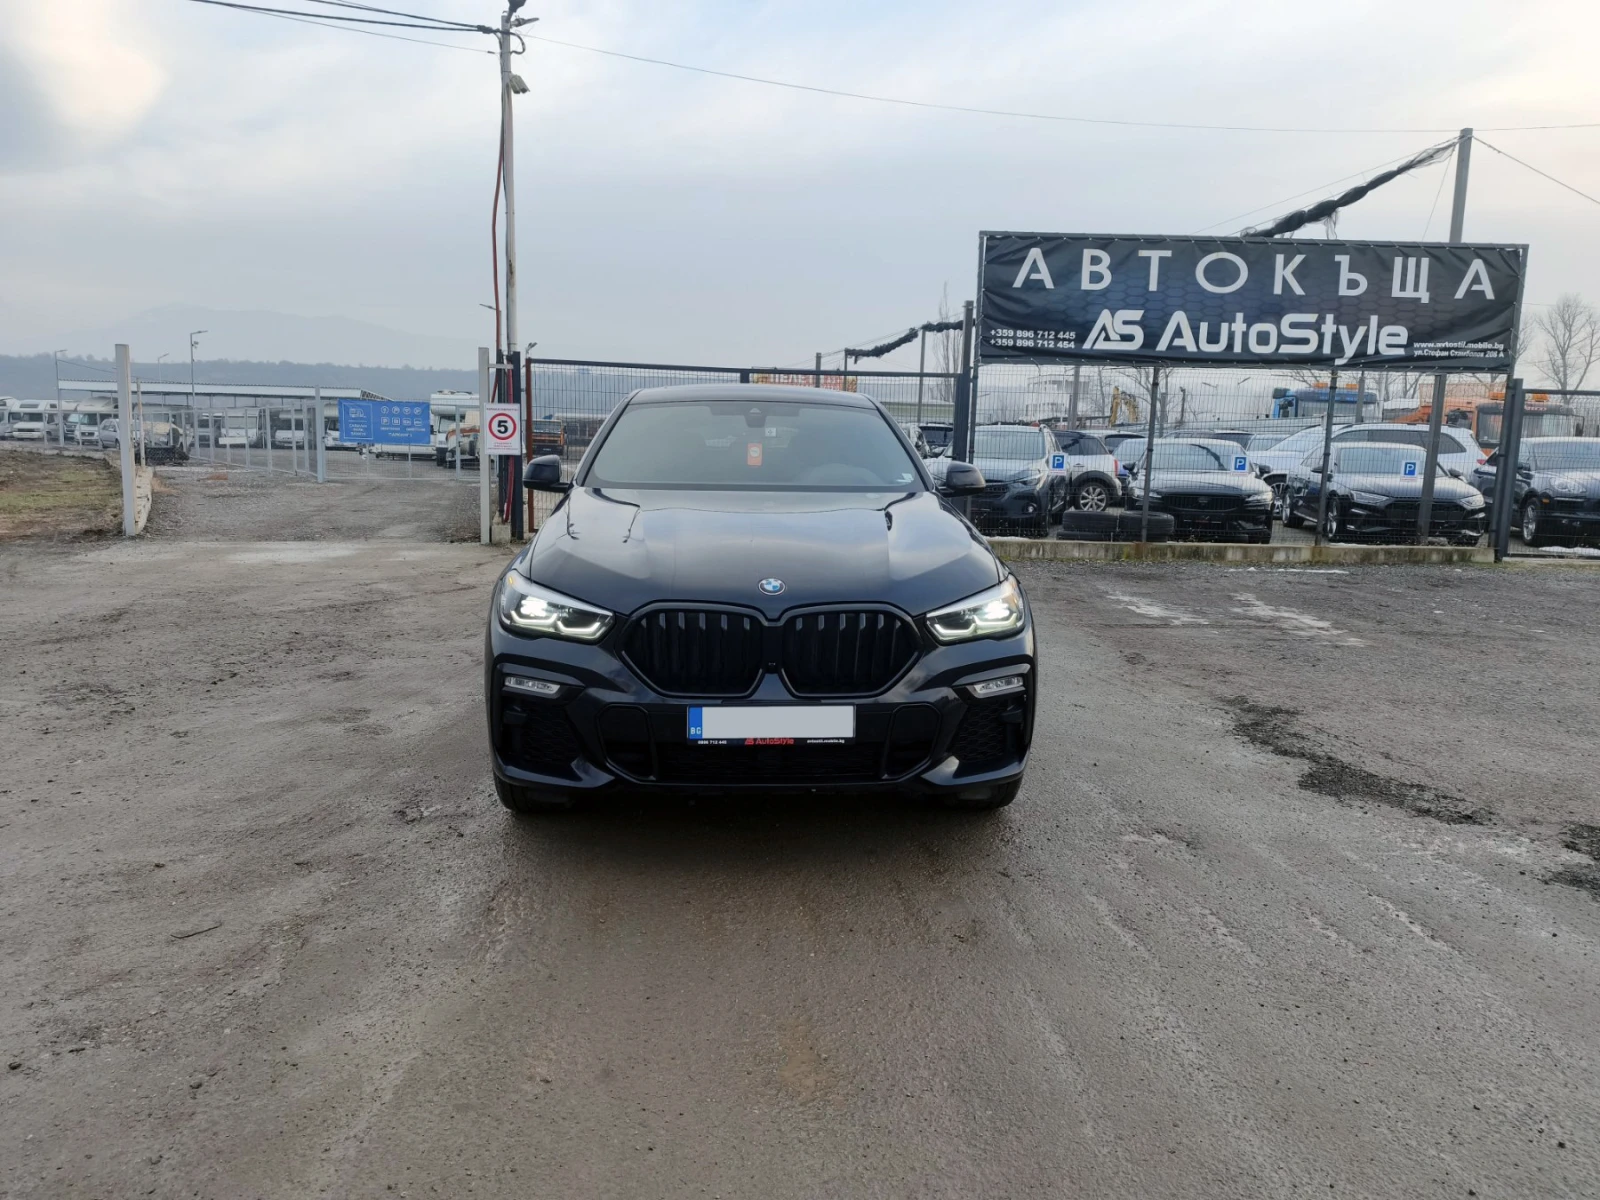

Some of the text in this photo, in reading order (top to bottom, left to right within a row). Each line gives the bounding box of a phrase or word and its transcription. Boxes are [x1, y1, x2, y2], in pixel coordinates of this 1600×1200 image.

[1012, 247, 1495, 304] АВТОКЪЩА
[990, 328, 1076, 340] +359 896 712 445
[1082, 308, 1409, 366] AS AutoStyle
[990, 338, 1075, 349] +359 896 712 454
[1413, 341, 1504, 351] www.avtostil.mobile.bg
[497, 420, 508, 434] 5
[1055, 456, 1063, 467] P
[1236, 458, 1245, 469] P
[1406, 463, 1415, 474] P
[690, 726, 702, 735] BG
